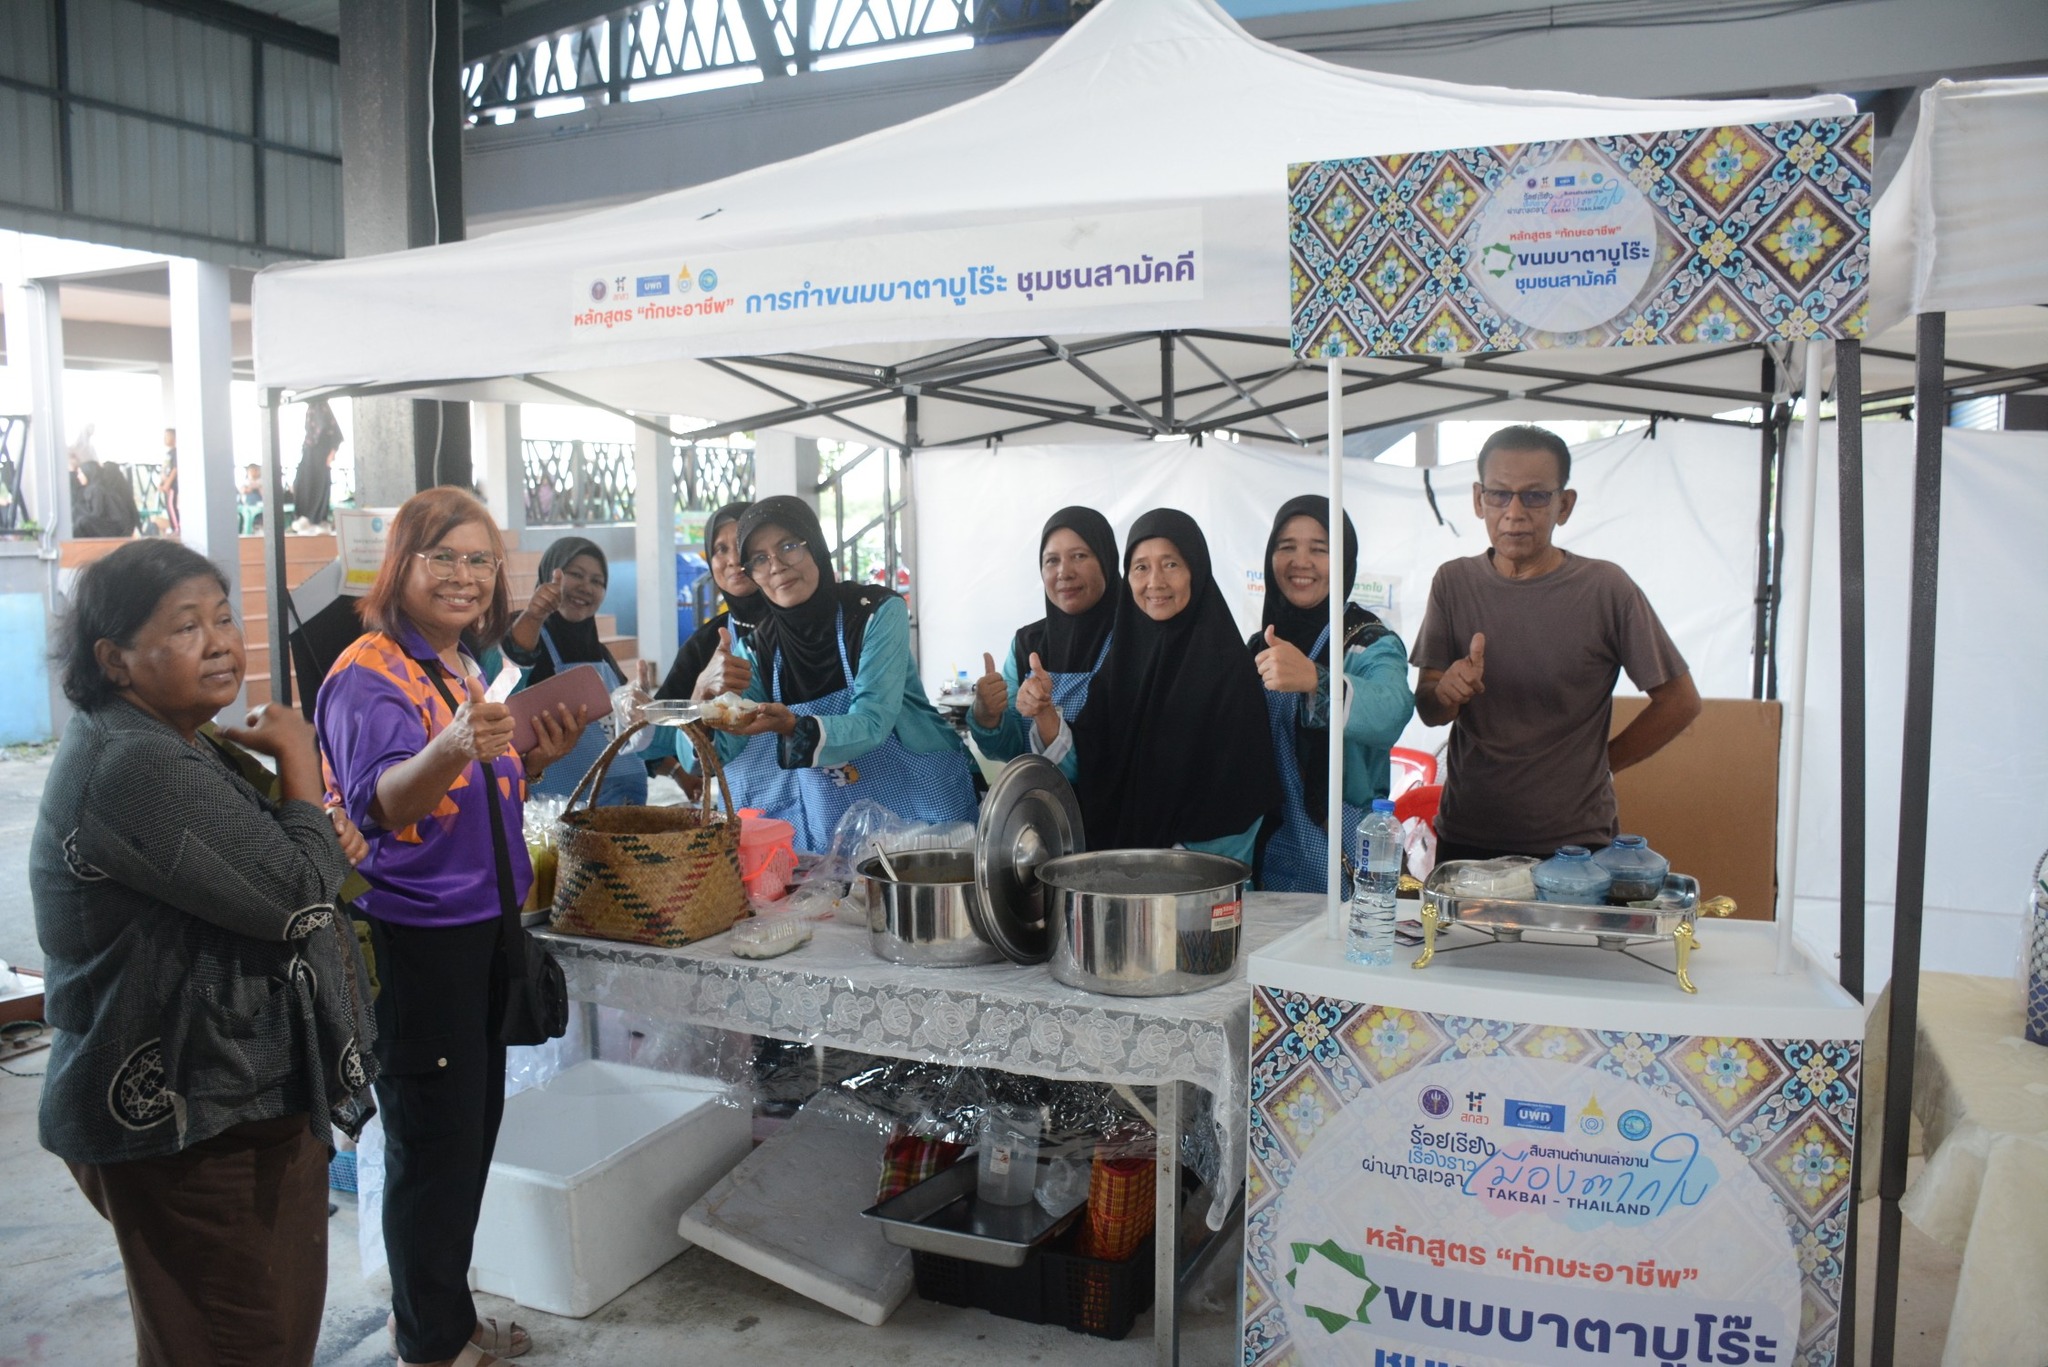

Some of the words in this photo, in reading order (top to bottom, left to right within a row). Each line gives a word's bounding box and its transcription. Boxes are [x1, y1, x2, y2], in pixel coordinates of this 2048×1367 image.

[1510, 229, 1552, 242] หลักสูตร
[1517, 241, 1650, 267] ขนมบาตาบูโร๊ะ
[745, 265, 1007, 314] การทำขนมบาตาบูโร๊ะ
[1016, 251, 1195, 301] ชุมชนสามัคคี
[1515, 268, 1617, 294] ชุมชนสามัคคี
[573, 307, 633, 329] หลักสูตร
[1460, 1112, 1490, 1126] สกสว
[1410, 1124, 1496, 1157] ร้อยเรียง
[1361, 1155, 1465, 1188] ผ่านกาลเวลา
[1486, 1187, 1546, 1205] TAKBAI
[1567, 1197, 1650, 1216] THAILAND
[1365, 1225, 1486, 1267] หลักสูตร
